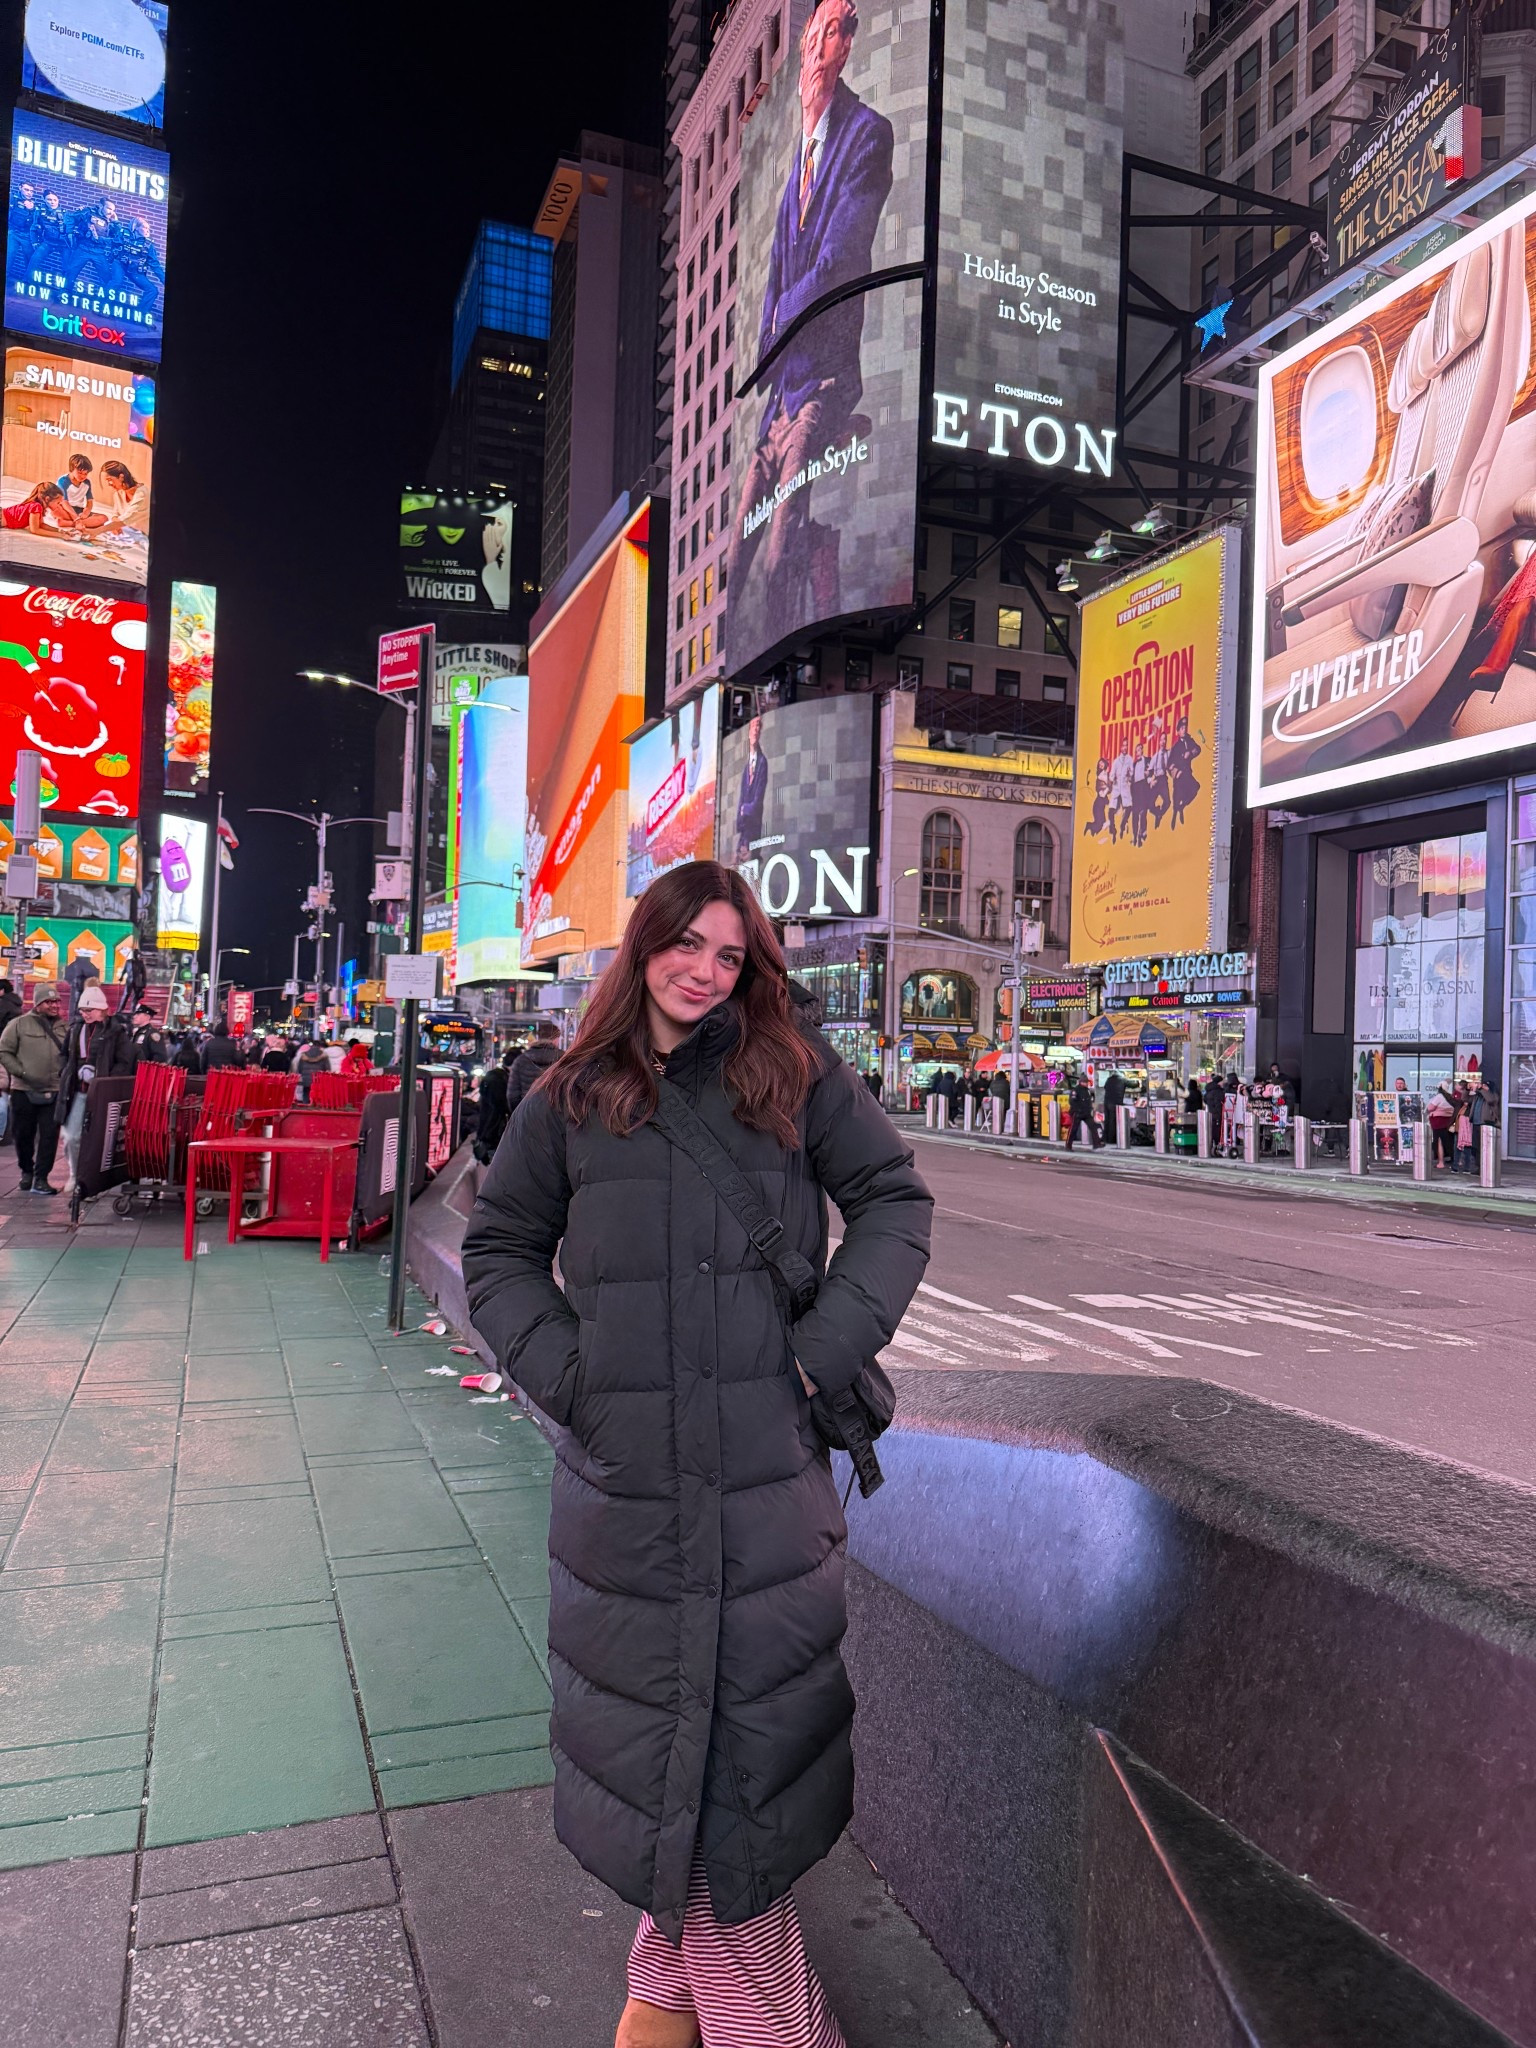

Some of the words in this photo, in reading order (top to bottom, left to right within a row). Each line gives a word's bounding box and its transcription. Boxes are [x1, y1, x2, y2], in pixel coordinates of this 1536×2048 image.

[49, 21, 80, 39] Explore
[81, 31, 145, 60] PGIM.com/ETFs
[1391, 70, 1439, 134] JORDAN
[1340, 170, 1370, 208] SINGS
[1371, 147, 1389, 171] HIS
[1391, 111, 1419, 152] FACE
[1421, 78, 1450, 118] OFF!
[17, 136, 78, 178] BLUE
[84, 154, 165, 201] LIGHTS
[1342, 199, 1356, 216] VOICE
[1357, 179, 1374, 199] SOARS
[1374, 170, 1382, 180] TO
[1382, 161, 1393, 174] THE
[1393, 143, 1409, 163] BACK
[1409, 131, 1417, 143] OF
[1418, 117, 1430, 133] THE
[1337, 203, 1371, 267] THE
[1421, 234, 1446, 260] JACKSON
[1426, 231, 1441, 249] AISHA
[33, 270, 67, 289] NEW
[76, 280, 140, 307] SEASON
[963, 253, 1036, 297] Holiday
[1037, 272, 1097, 307] Season
[16, 281, 54, 302] NOW
[61, 295, 154, 326] STREAMING
[998, 299, 1016, 321] in
[1018, 302, 1062, 334] Style
[42, 308, 126, 347] britbox
[25, 364, 136, 403] SAMSUNG
[994, 383, 1063, 407] ETONSHIRTS.COM
[36, 421, 68, 441] Play
[69, 429, 122, 449] around
[931, 391, 1117, 478] ETON
[743, 492, 774, 540] Holiday
[773, 470, 806, 508] Season
[807, 459, 821, 481] in
[823, 436, 868, 476] Style
[23, 586, 118, 625] Coca-Cola
[1118, 606, 1137, 625] VERY
[1137, 600, 1151, 615] BIG
[1151, 586, 1180, 609] FUTURE
[1131, 588, 1148, 603] LITTLE
[1147, 581, 1163, 595] SHOW
[382, 640, 392, 652] NO
[393, 634, 420, 650] STOPPIN
[382, 651, 409, 666] Anytime
[436, 647, 480, 670] LITTLE
[485, 647, 517, 673] SHOP
[1101, 644, 1194, 722] OPERATION
[1285, 660, 1326, 717] FLY
[1330, 629, 1424, 703] BETTER
[913, 778, 938, 791] THE
[943, 781, 980, 796] SHOW
[986, 786, 1025, 801] FOLKS
[1032, 791, 1064, 805] SHOE
[1113, 903, 1130, 911] NEW
[1133, 897, 1171, 908] MUSICAL
[1105, 960, 1150, 984] GIFTS
[1162, 952, 1248, 980] LUGGAGE
[1168, 980, 1187, 993] NY
[1030, 983, 1086, 998] ELECTRONICS
[1031, 999, 1056, 1008] CAMERA
[1058, 999, 1087, 1007] LUGGAGE
[1129, 997, 1149, 1007] Nikon
[1152, 996, 1179, 1006] Canon
[1184, 993, 1214, 1004] SONY
[1217, 991, 1241, 1003] BOWER
[1369, 985, 1391, 997] U.S.
[1395, 982, 1432, 997] POLO
[1437, 980, 1477, 995] ASSN.
[718, 1171, 764, 1224] BAG
[778, 1251, 816, 1298] BAG
